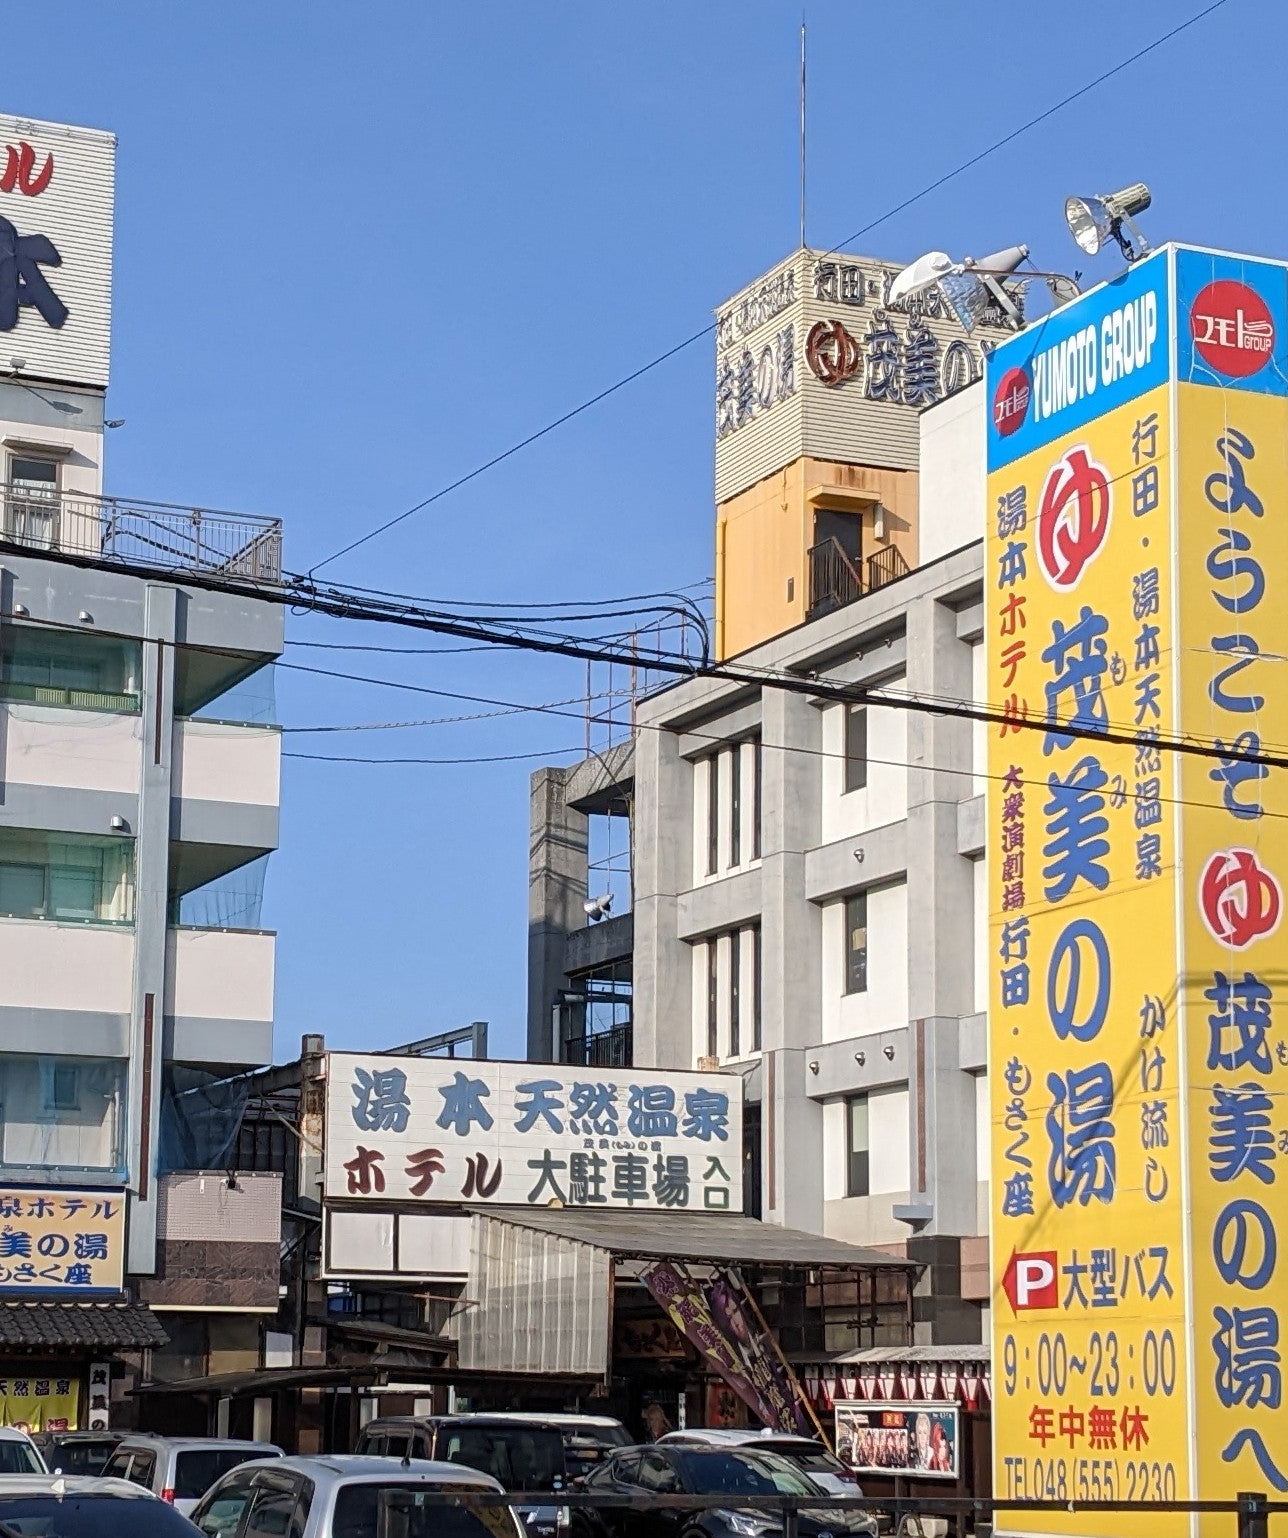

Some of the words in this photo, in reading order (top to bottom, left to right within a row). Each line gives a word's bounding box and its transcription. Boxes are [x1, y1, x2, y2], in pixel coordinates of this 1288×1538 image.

[1032, 325, 1096, 423] YUMOTO
[1102, 290, 1157, 387] GROUP
[1244, 335, 1272, 352] GROUP
[1132, 412, 1162, 880] 行田・湯本天然温泉
[351, 1066, 730, 1142] 湯本天然温泉
[1139, 994, 1169, 1203] かけ流し
[343, 1145, 503, 1198] ホテル
[526, 1148, 692, 1208] 大駐車場
[703, 1156, 731, 1210] 入口
[1016, 1259, 1055, 1306] P
[1062, 1246, 1174, 1311] 大型バス
[1028, 1404, 1150, 1452] 年中無休
